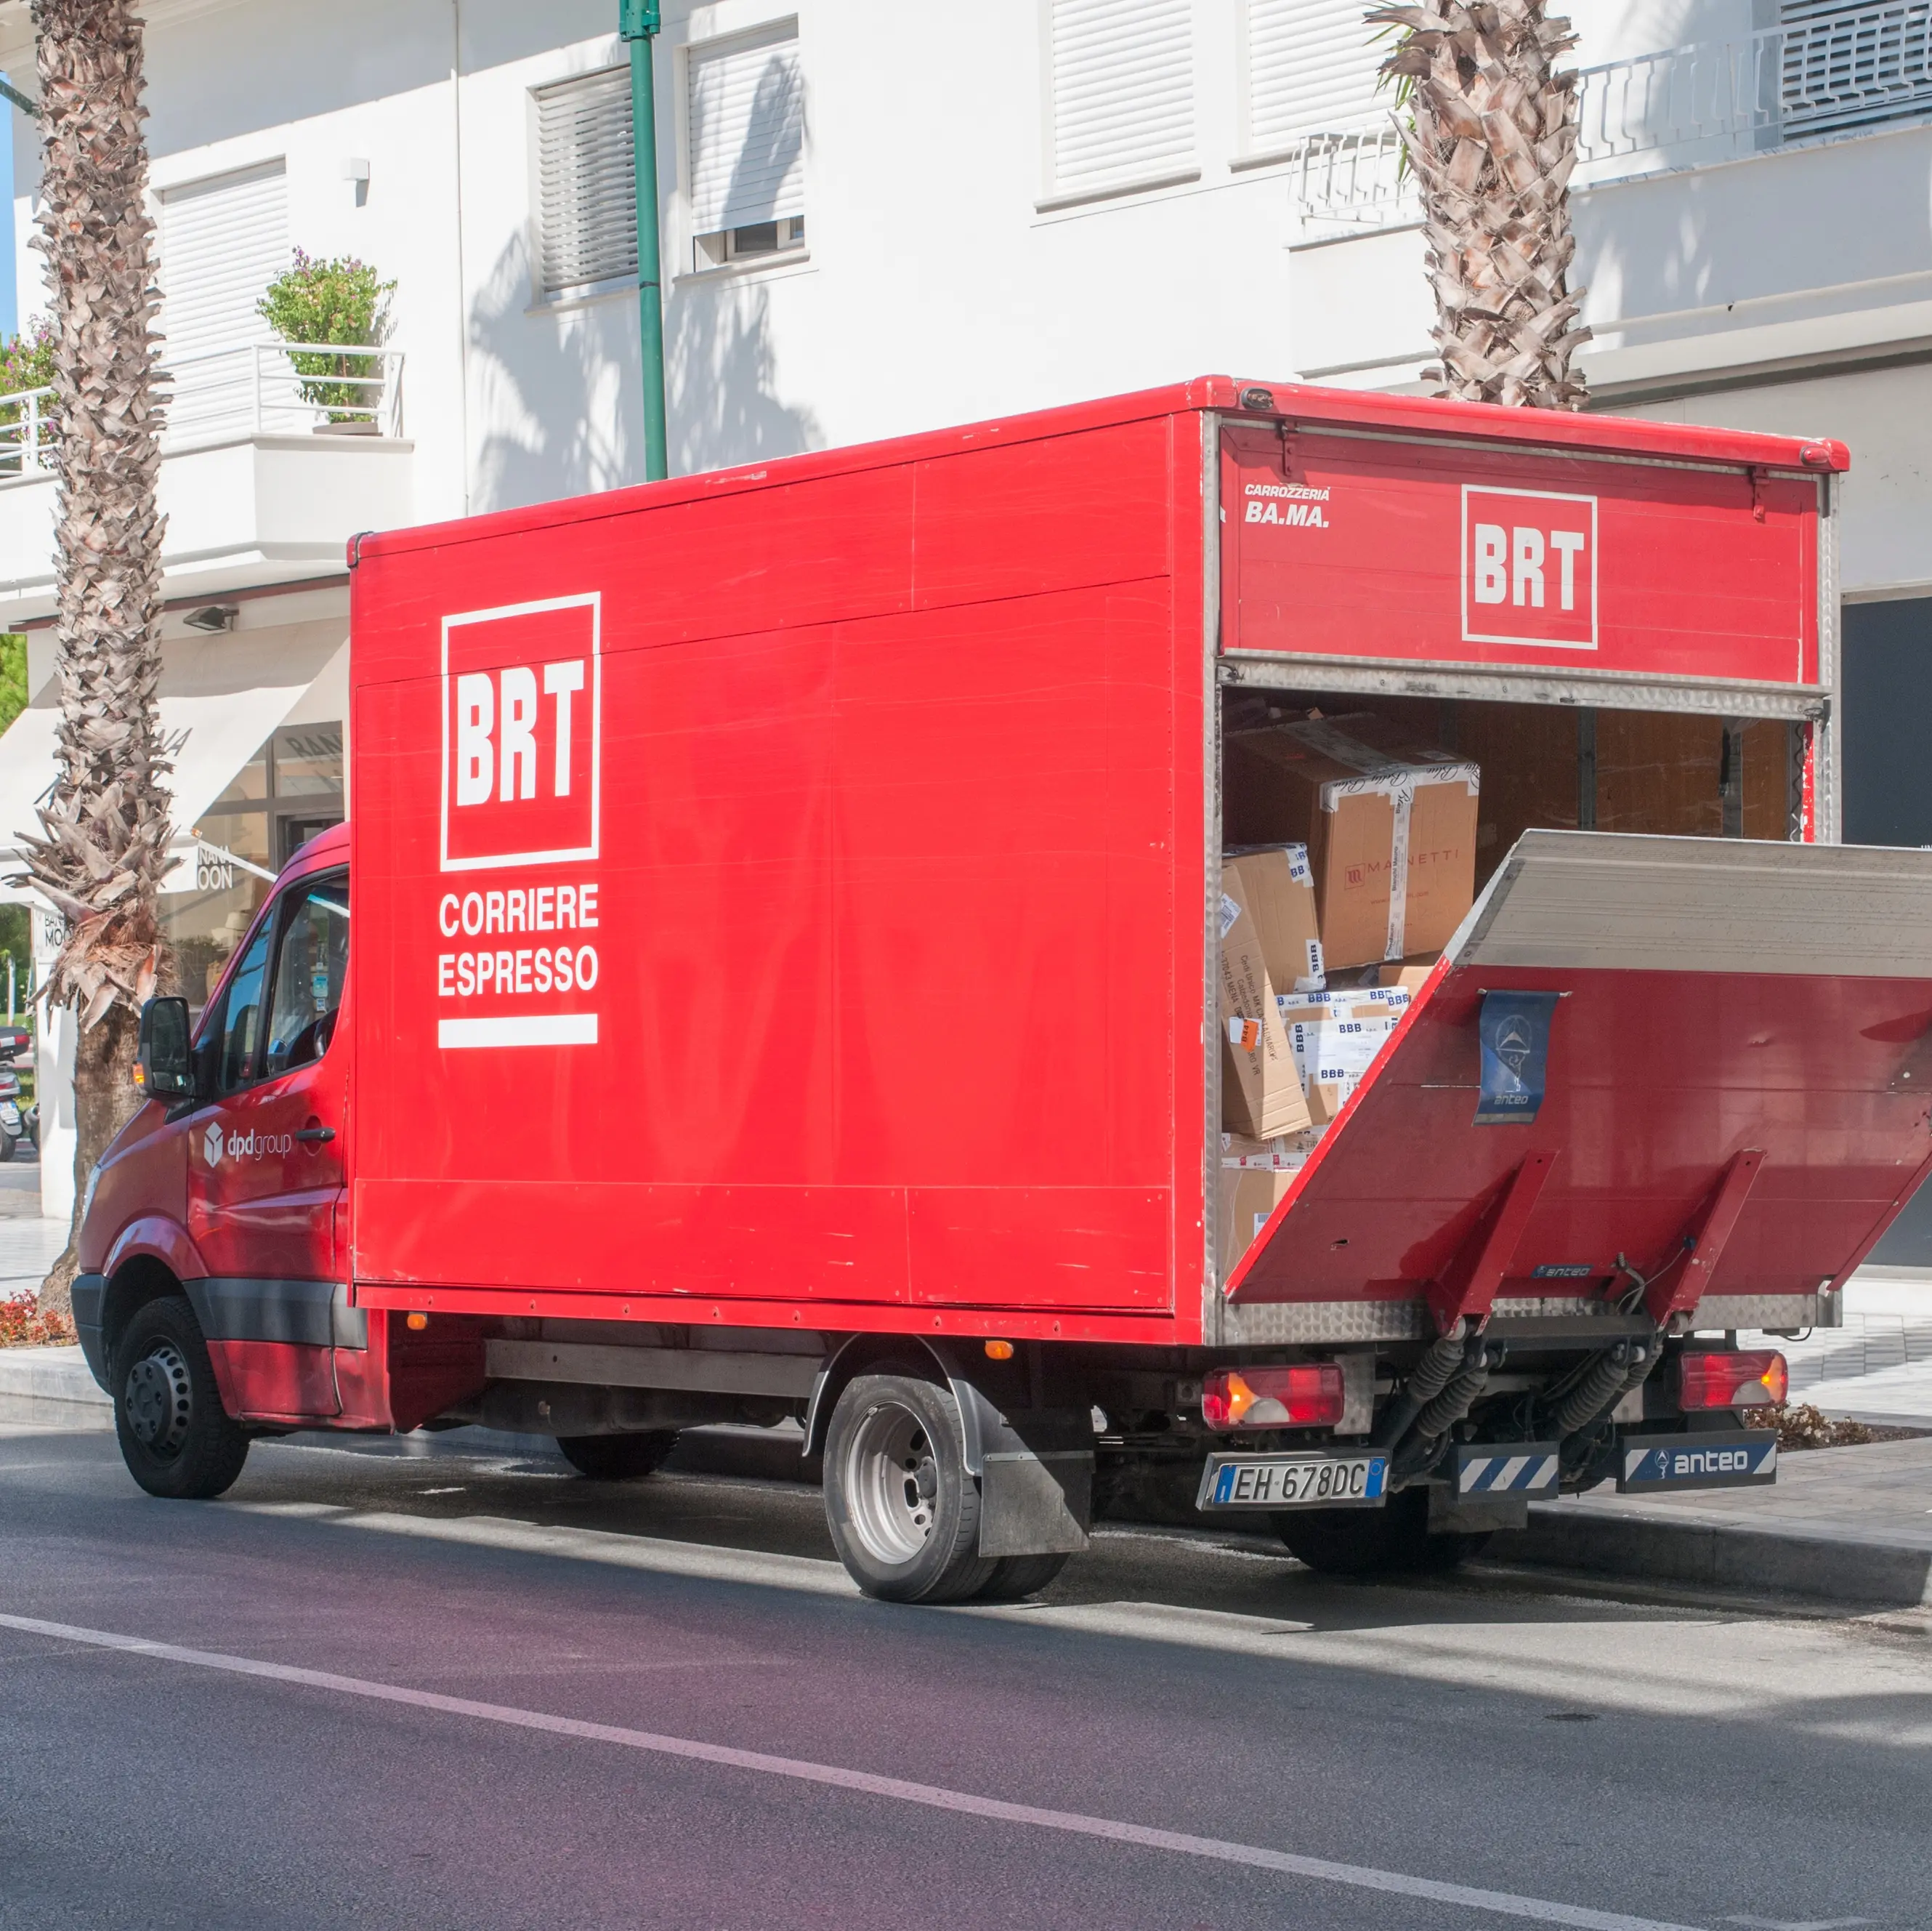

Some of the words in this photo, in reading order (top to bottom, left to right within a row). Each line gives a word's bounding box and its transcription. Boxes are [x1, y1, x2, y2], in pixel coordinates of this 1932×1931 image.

[1245, 484, 1330, 501] CARROZZERIA
[1245, 501, 1330, 528] BA.MA.
[1474, 523, 1585, 610] BRT
[456, 659, 585, 807] BRT
[1367, 849, 1459, 873] MANETTI
[439, 884, 599, 938] CORRIERE
[438, 945, 599, 996] ESPRESSO
[1308, 993, 1330, 1003] BBB
[1296, 1024, 1304, 1052] BBB
[1339, 1023, 1362, 1033] BBB
[1321, 1069, 1344, 1079] BBB
[1494, 1094, 1529, 1105] anteo
[227, 1128, 291, 1162] dpdgroup
[1674, 1451, 1748, 1474] anteo
[1234, 1469, 1273, 1500] EH
[1282, 1463, 1365, 1499] 678DC
